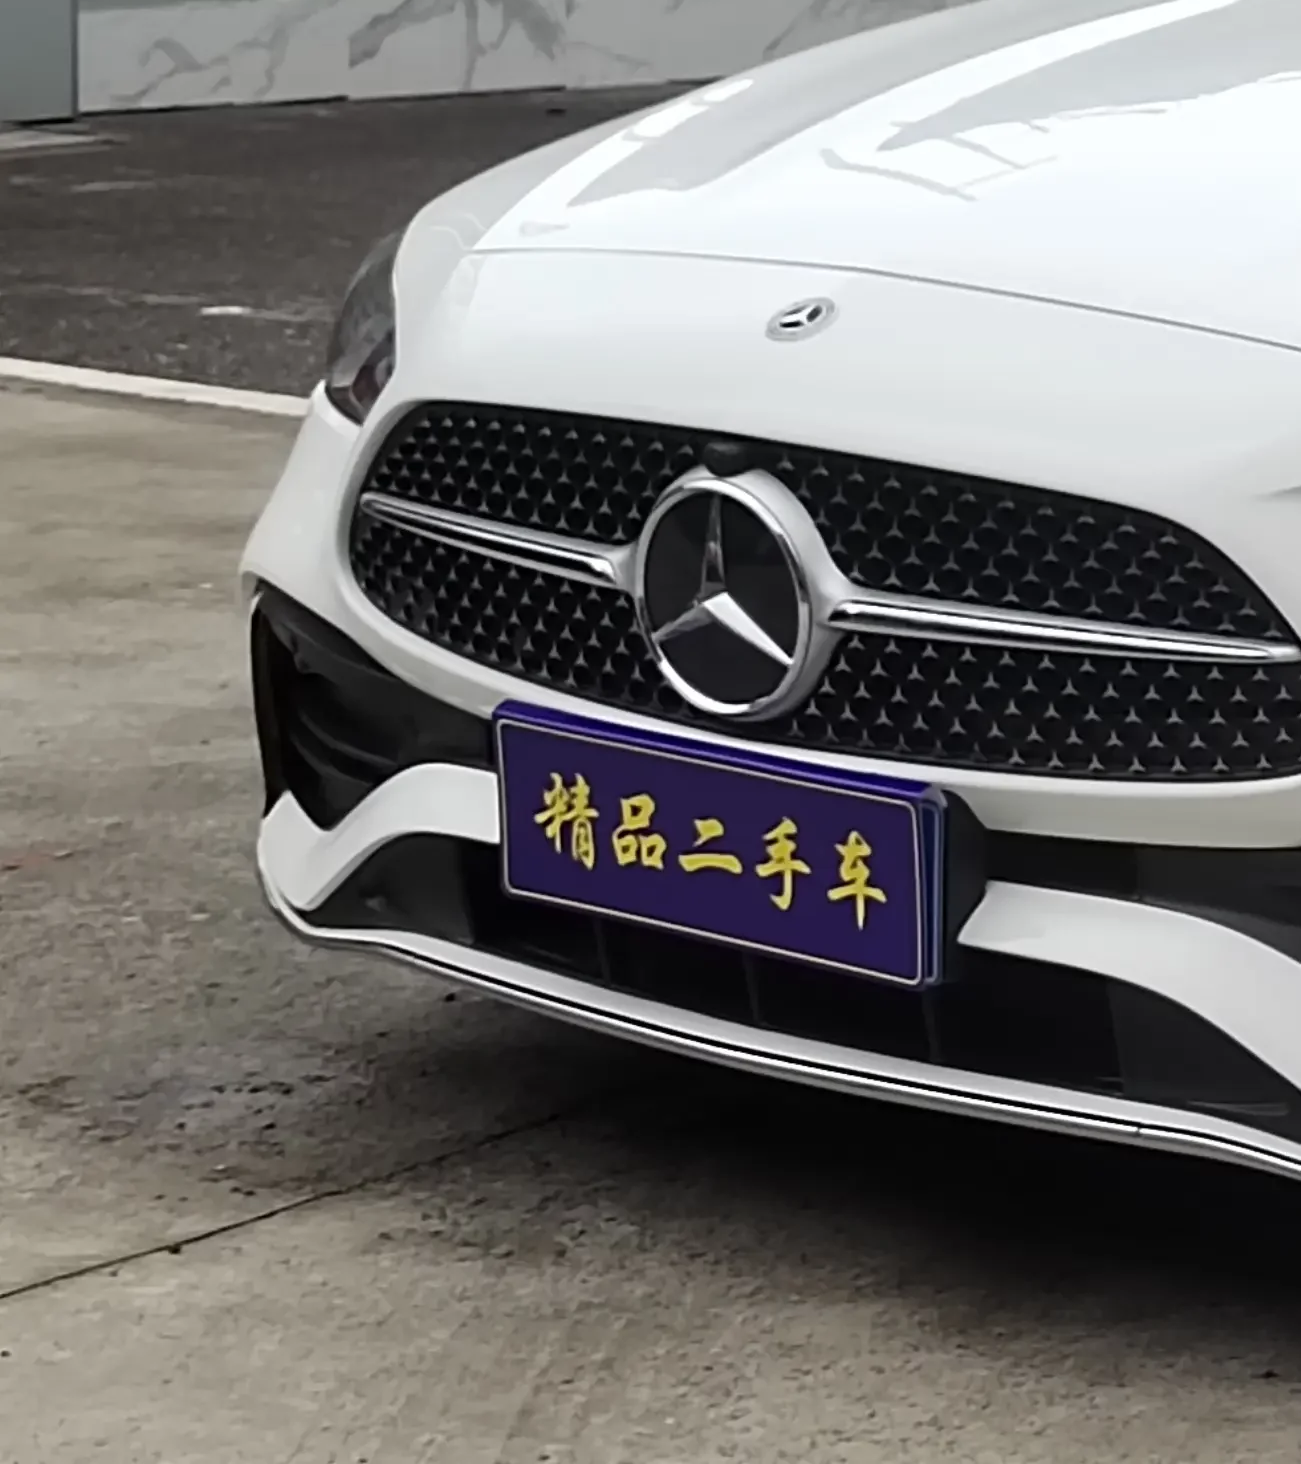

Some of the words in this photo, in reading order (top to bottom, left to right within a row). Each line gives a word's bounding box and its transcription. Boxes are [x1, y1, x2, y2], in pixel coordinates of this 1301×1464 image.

[534, 773, 887, 930] 精品二手车
